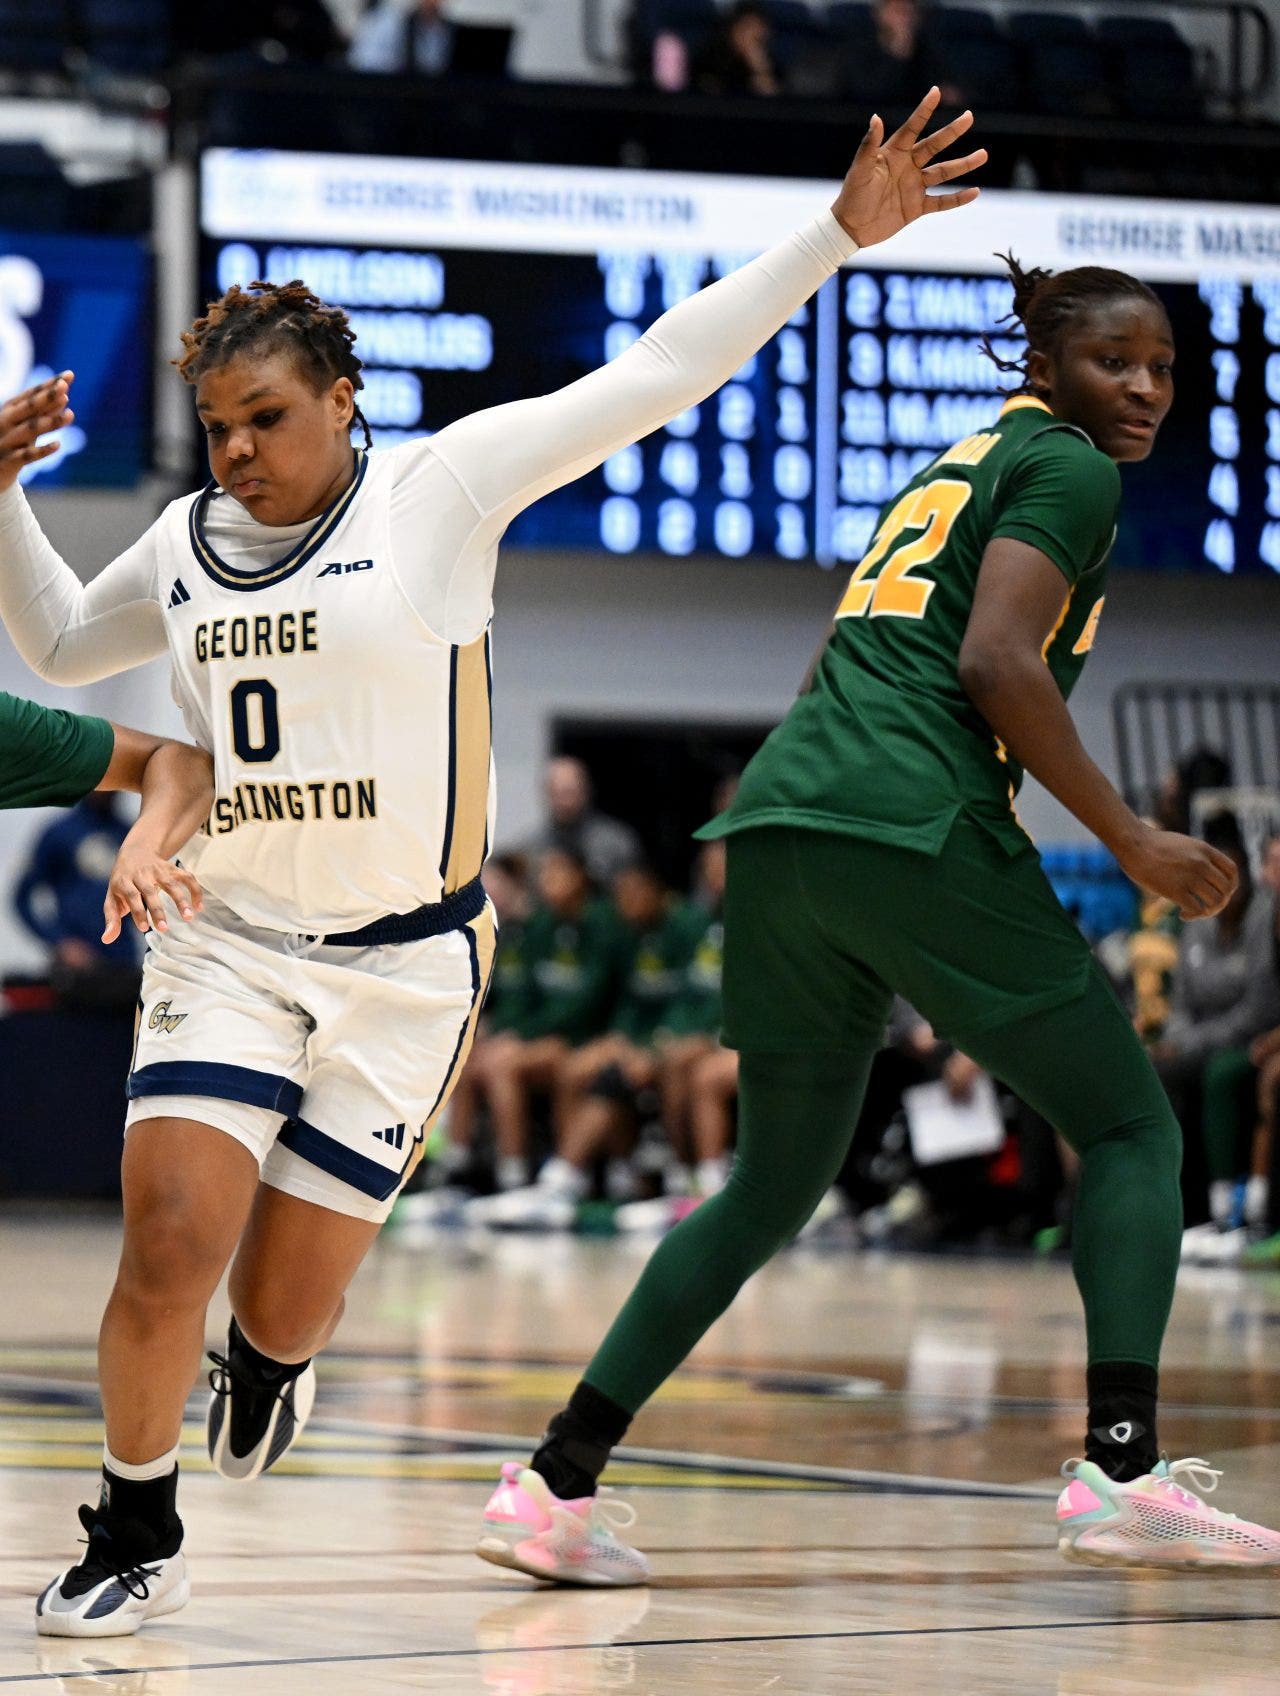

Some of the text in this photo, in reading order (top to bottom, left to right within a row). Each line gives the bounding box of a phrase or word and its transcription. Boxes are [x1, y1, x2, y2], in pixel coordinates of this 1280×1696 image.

[472, 184, 697, 226] WASHINGTON
[1057, 215, 1184, 260] GEORGE
[315, 559, 375, 579] A10
[834, 478, 973, 619] 22
[195, 609, 319, 664] GEORGE
[229, 675, 281, 765] 0
[204, 778, 378, 838] SHINGTON
[148, 999, 189, 1034] GW
